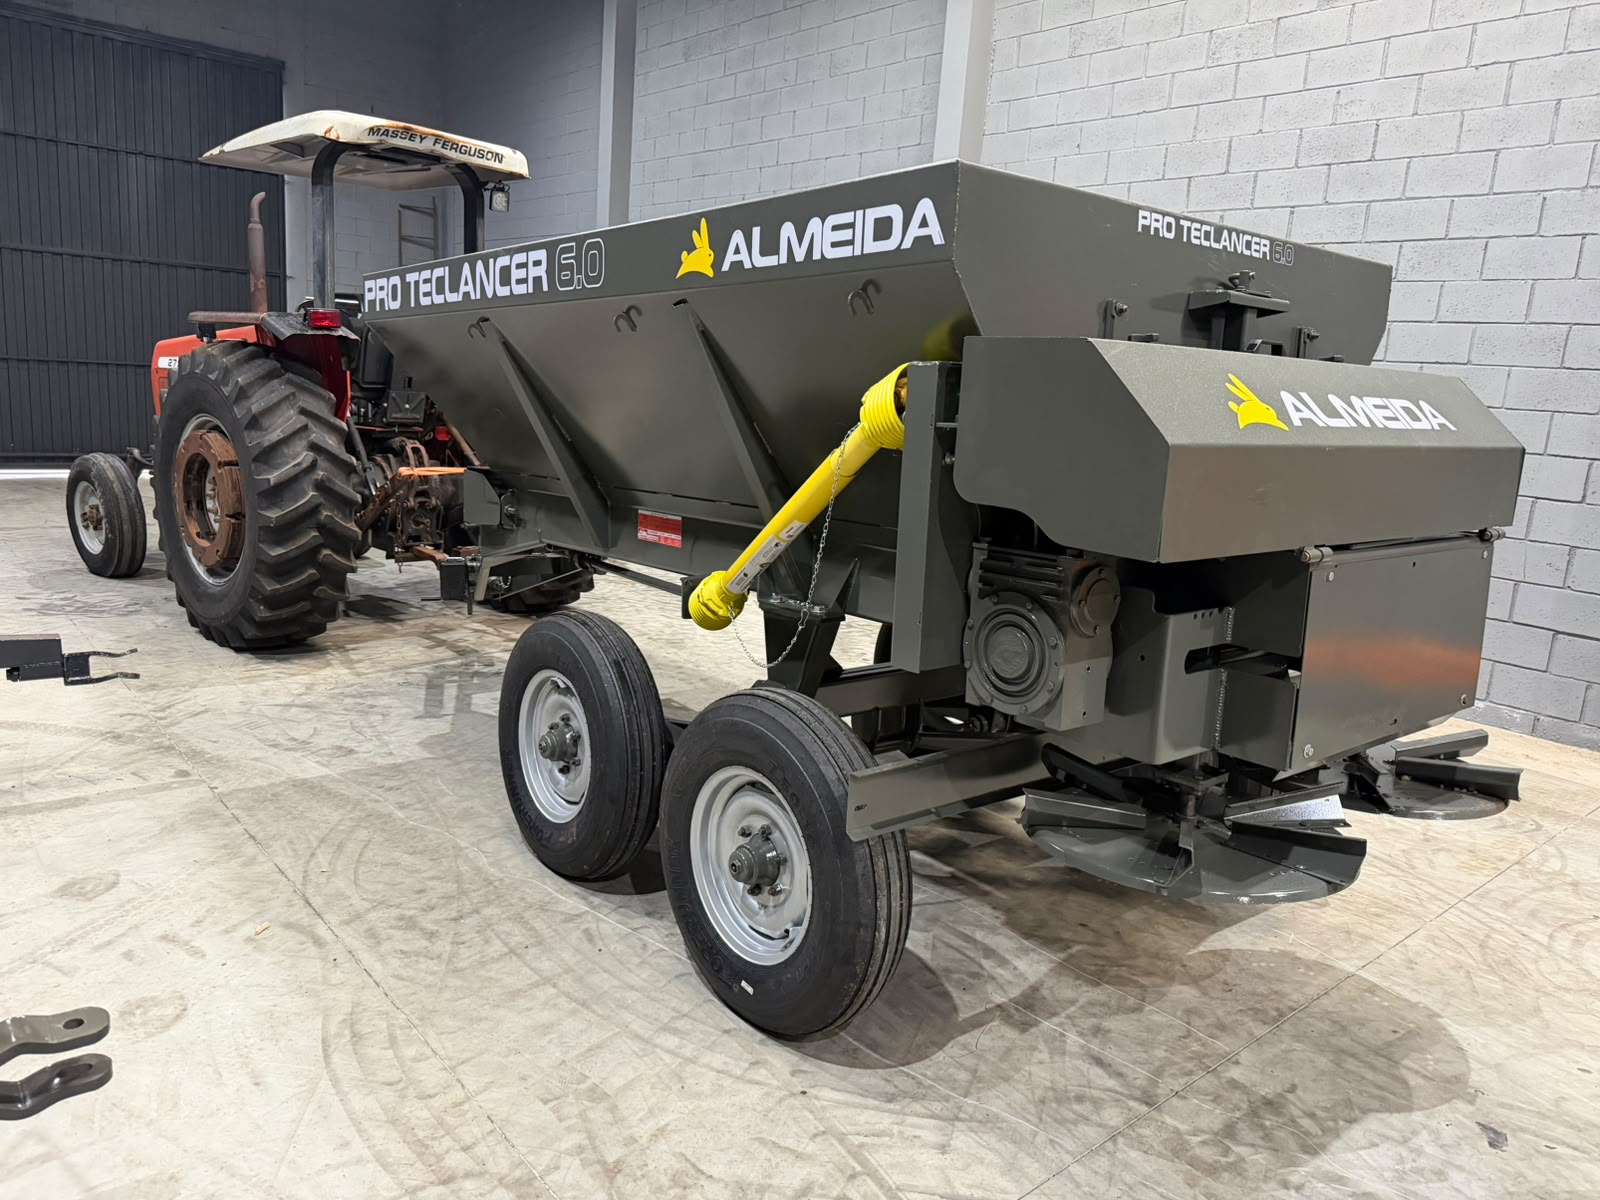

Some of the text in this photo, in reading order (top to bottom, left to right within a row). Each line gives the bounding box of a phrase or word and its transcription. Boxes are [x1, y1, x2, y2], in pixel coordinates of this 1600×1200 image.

[367, 127, 505, 164] MASSEY FERGUSON
[721, 197, 945, 272] ALMEIDA
[1138, 209, 1294, 266] PRO TECLANCER 6.0
[364, 238, 605, 313] PRO TECLANCER 6.0
[1280, 390, 1457, 431] ALMEIDA
